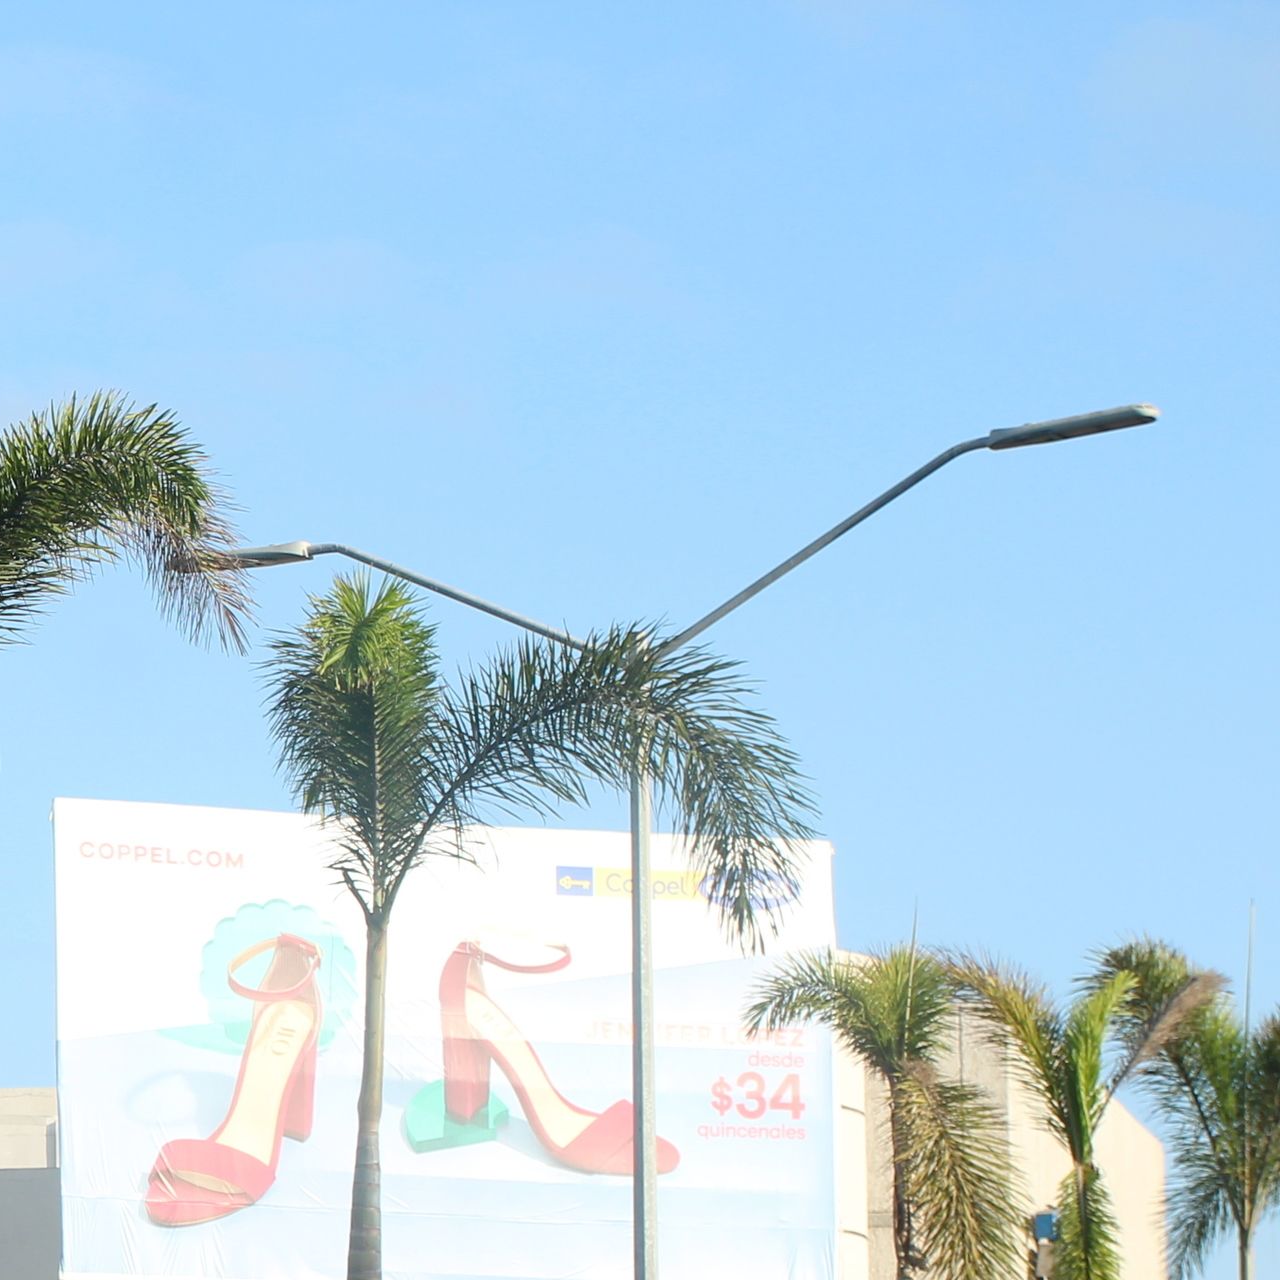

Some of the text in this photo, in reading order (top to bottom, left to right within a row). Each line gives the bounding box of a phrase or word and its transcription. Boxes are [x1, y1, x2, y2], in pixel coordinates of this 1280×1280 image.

[79, 841, 244, 869] COPPEL.COM
[606, 872, 688, 900] Copel
[748, 1051, 805, 1068] desde
[710, 1070, 806, 1121] $34
[697, 1122, 807, 1141] quincenales
